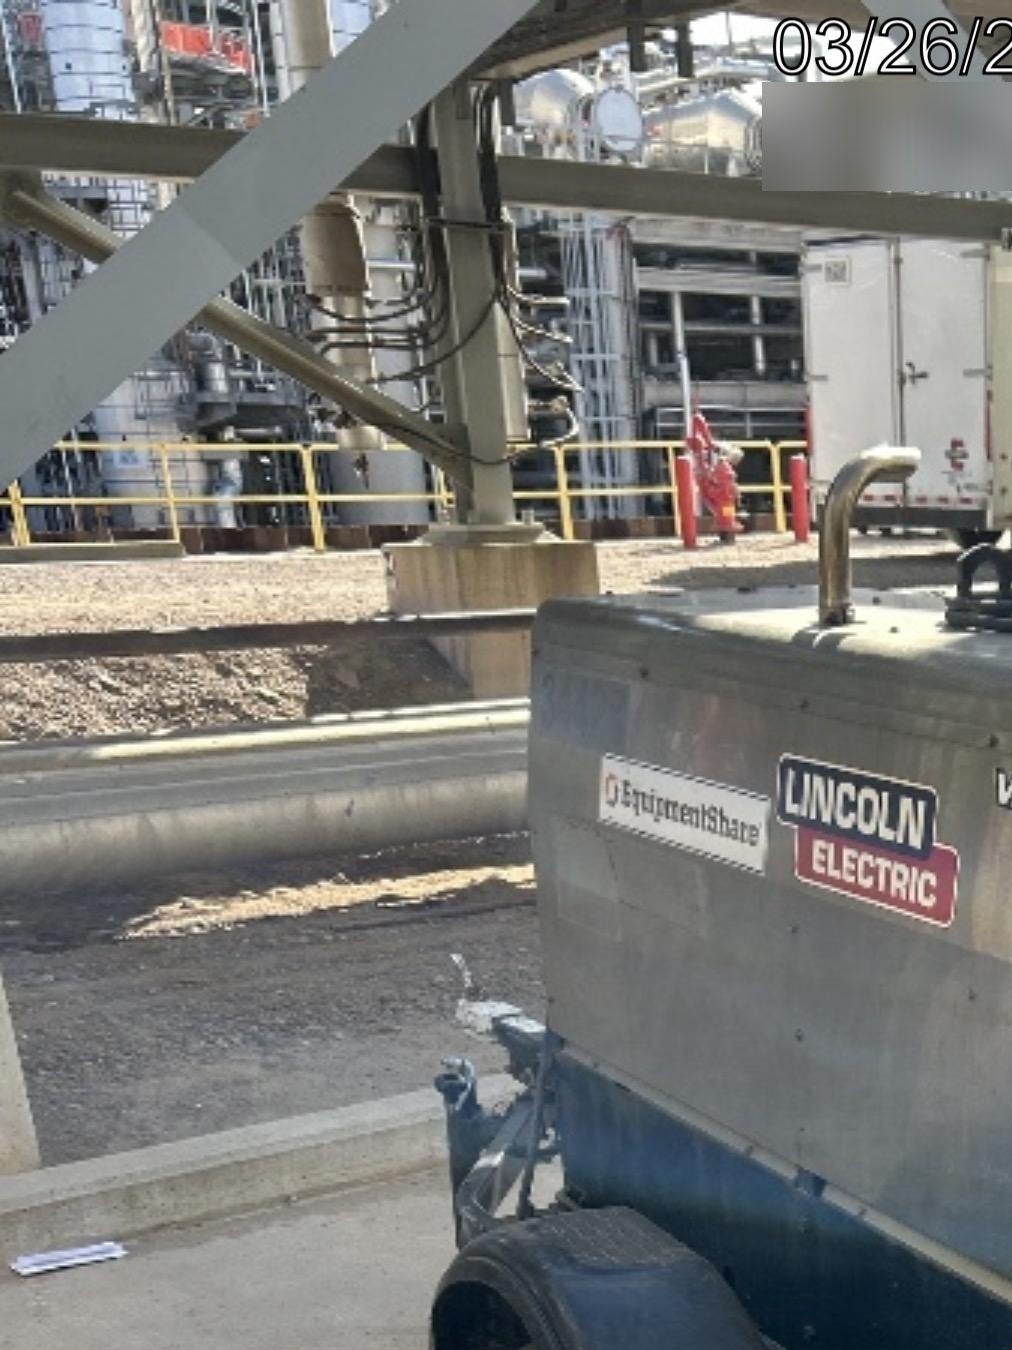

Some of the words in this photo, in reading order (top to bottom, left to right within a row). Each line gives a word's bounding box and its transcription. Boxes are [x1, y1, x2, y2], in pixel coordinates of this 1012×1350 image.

[621, 779, 760, 847] EquipmentShare
[784, 767, 927, 850] LINCOLN
[811, 839, 938, 908] ELECTRIC
